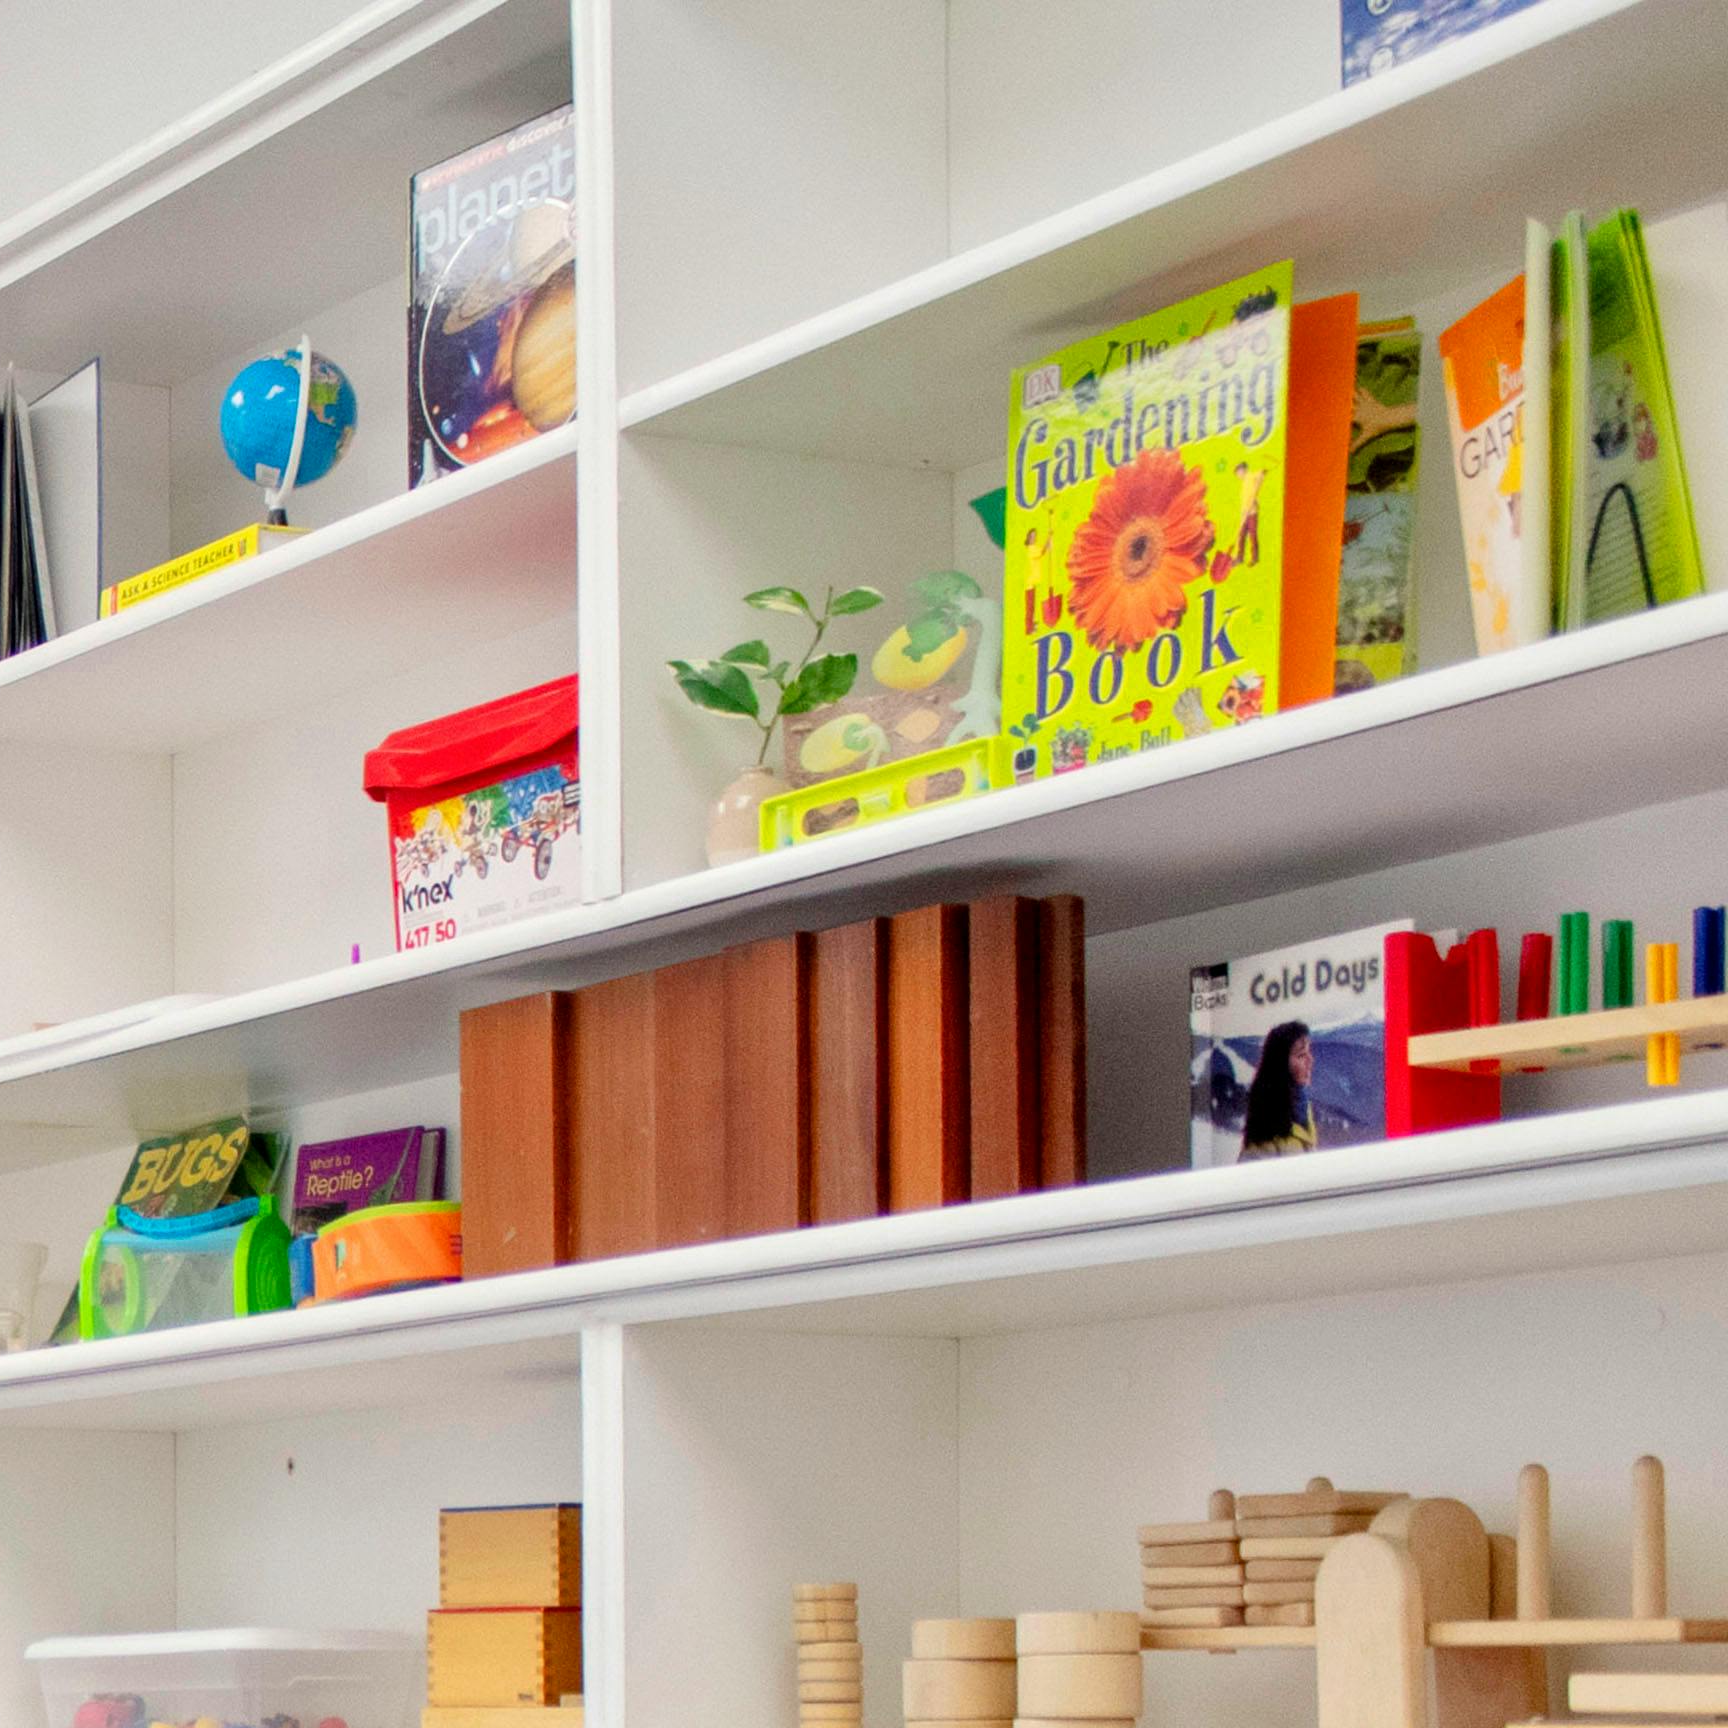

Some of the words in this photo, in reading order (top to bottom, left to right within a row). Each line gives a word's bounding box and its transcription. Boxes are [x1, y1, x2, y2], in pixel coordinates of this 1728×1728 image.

[1119, 333, 1171, 375] The
[1012, 355, 1279, 512] Gardening
[121, 582, 139, 599] ASK
[143, 581, 149, 591] A
[152, 562, 190, 588] SCIENCE
[193, 543, 235, 569] TEACHER
[1030, 586, 1245, 721] Book
[401, 874, 455, 915] k'nex
[435, 918, 456, 942] 50
[1249, 962, 1307, 1006] Cold
[1314, 957, 1380, 995] Days
[121, 1126, 248, 1205] BUGS
[306, 1165, 374, 1198] Reptile?
[309, 1156, 334, 1172] What
